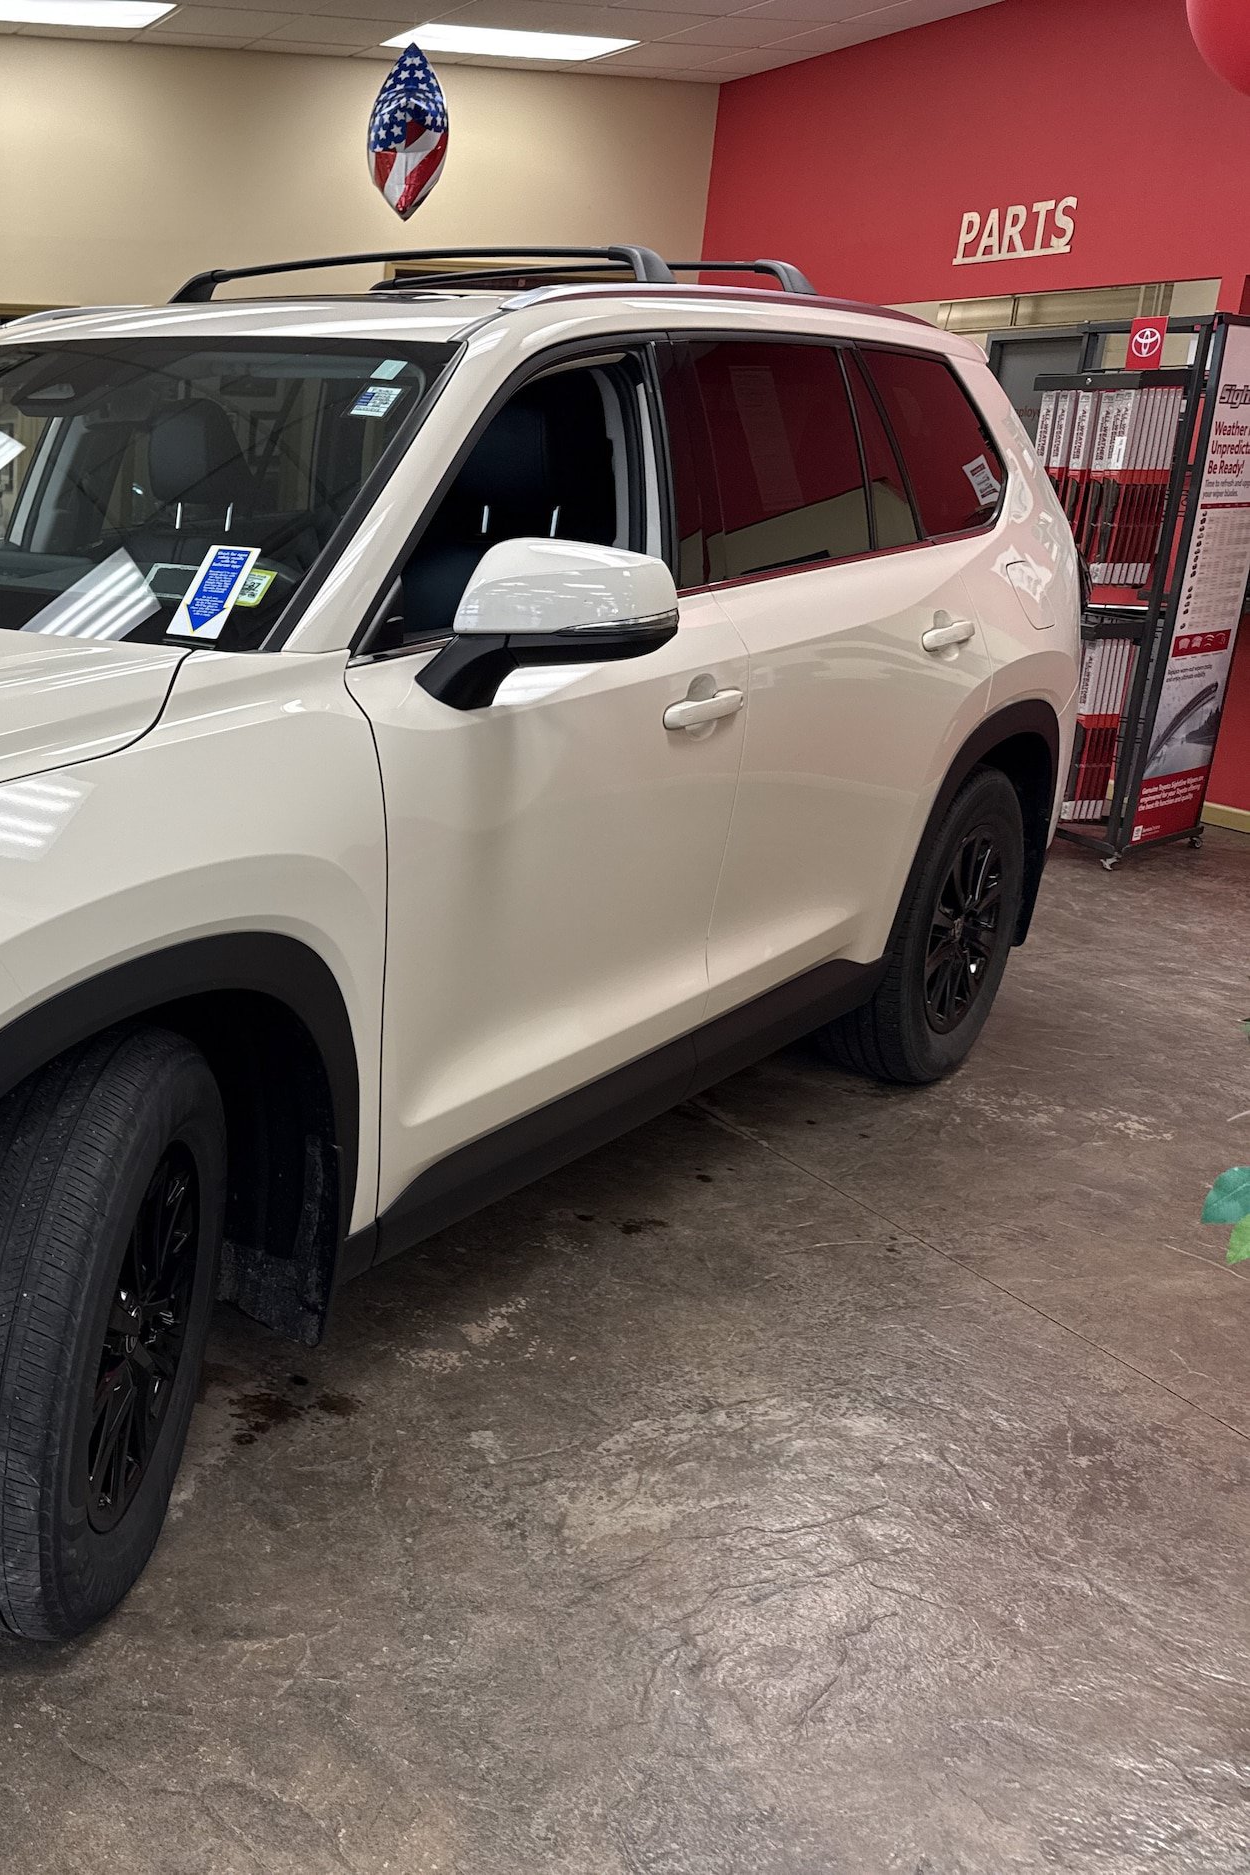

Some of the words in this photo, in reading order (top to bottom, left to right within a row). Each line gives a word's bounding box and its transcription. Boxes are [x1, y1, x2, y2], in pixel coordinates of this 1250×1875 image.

[955, 196, 1078, 261] PARTS
[1214, 421, 1247, 436] Weather
[1207, 460, 1217, 474] Be
[1218, 459, 1245, 477] Ready!
